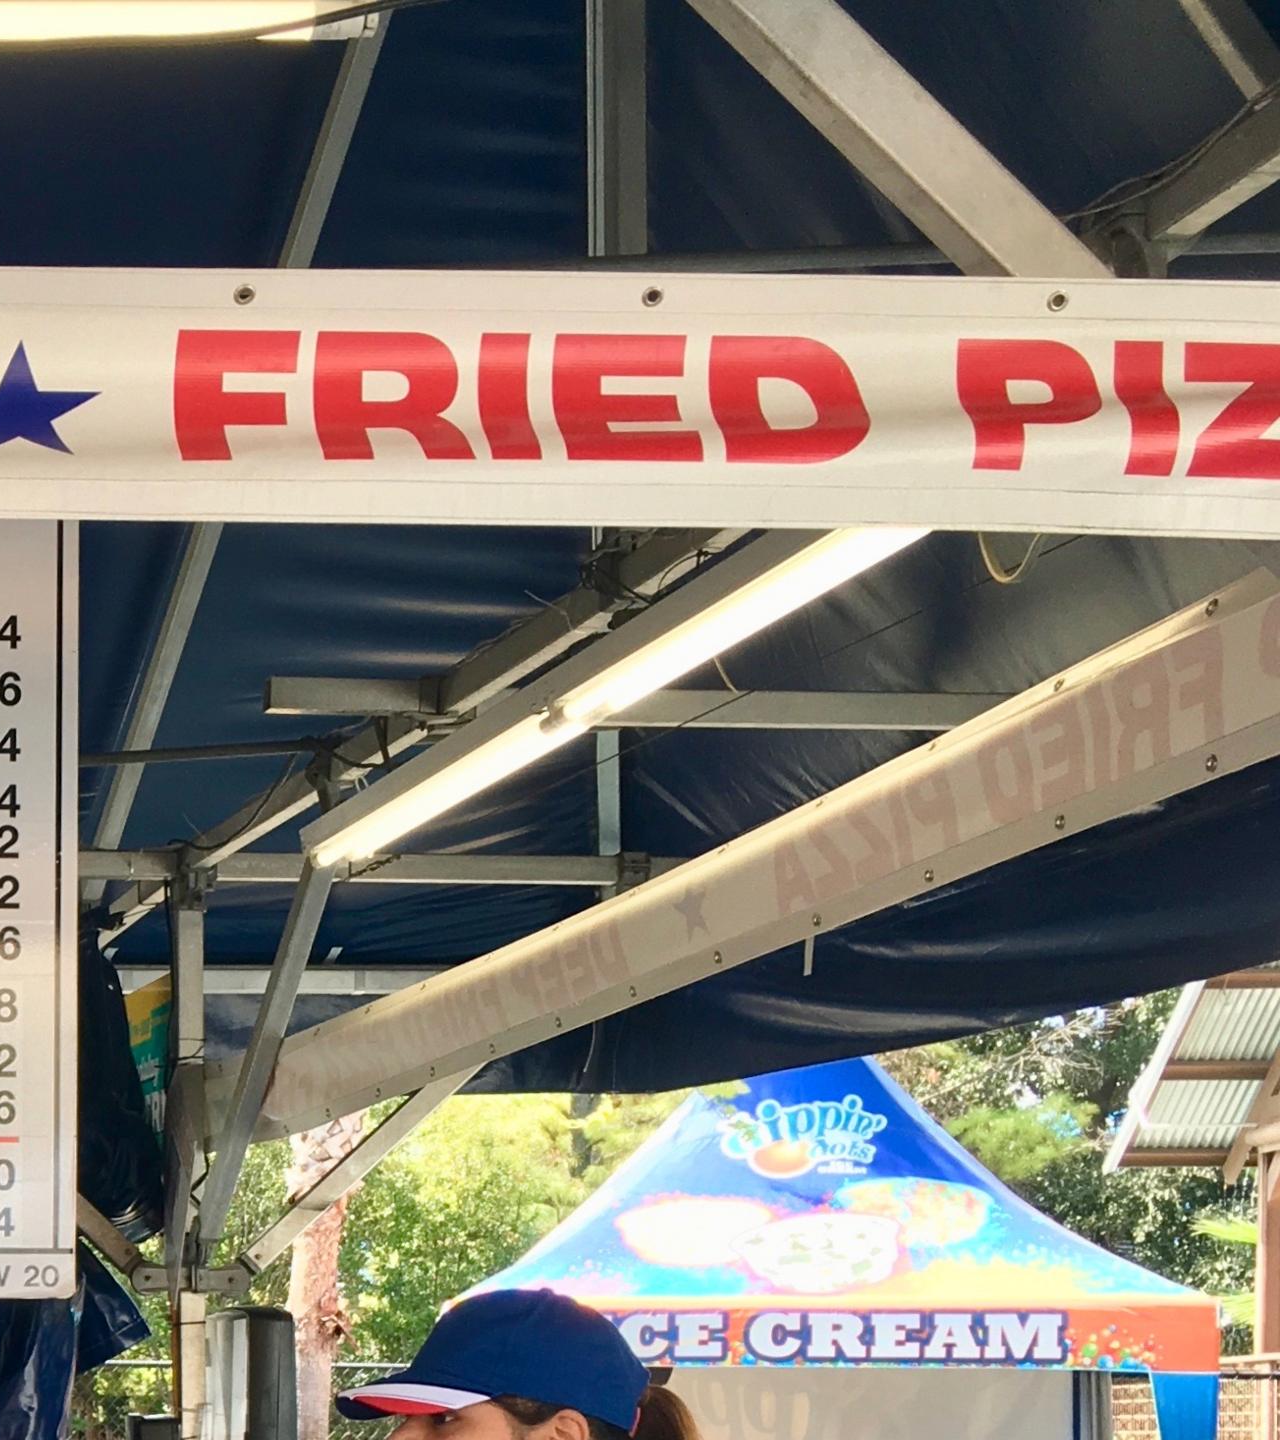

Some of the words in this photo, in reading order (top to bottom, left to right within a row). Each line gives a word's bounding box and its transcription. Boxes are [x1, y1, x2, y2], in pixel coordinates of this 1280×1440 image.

[173, 329, 870, 465] FRIED
[23, 1264, 60, 1288] 20
[613, 1314, 724, 1360] CE
[748, 1313, 1064, 1361] CREAM
